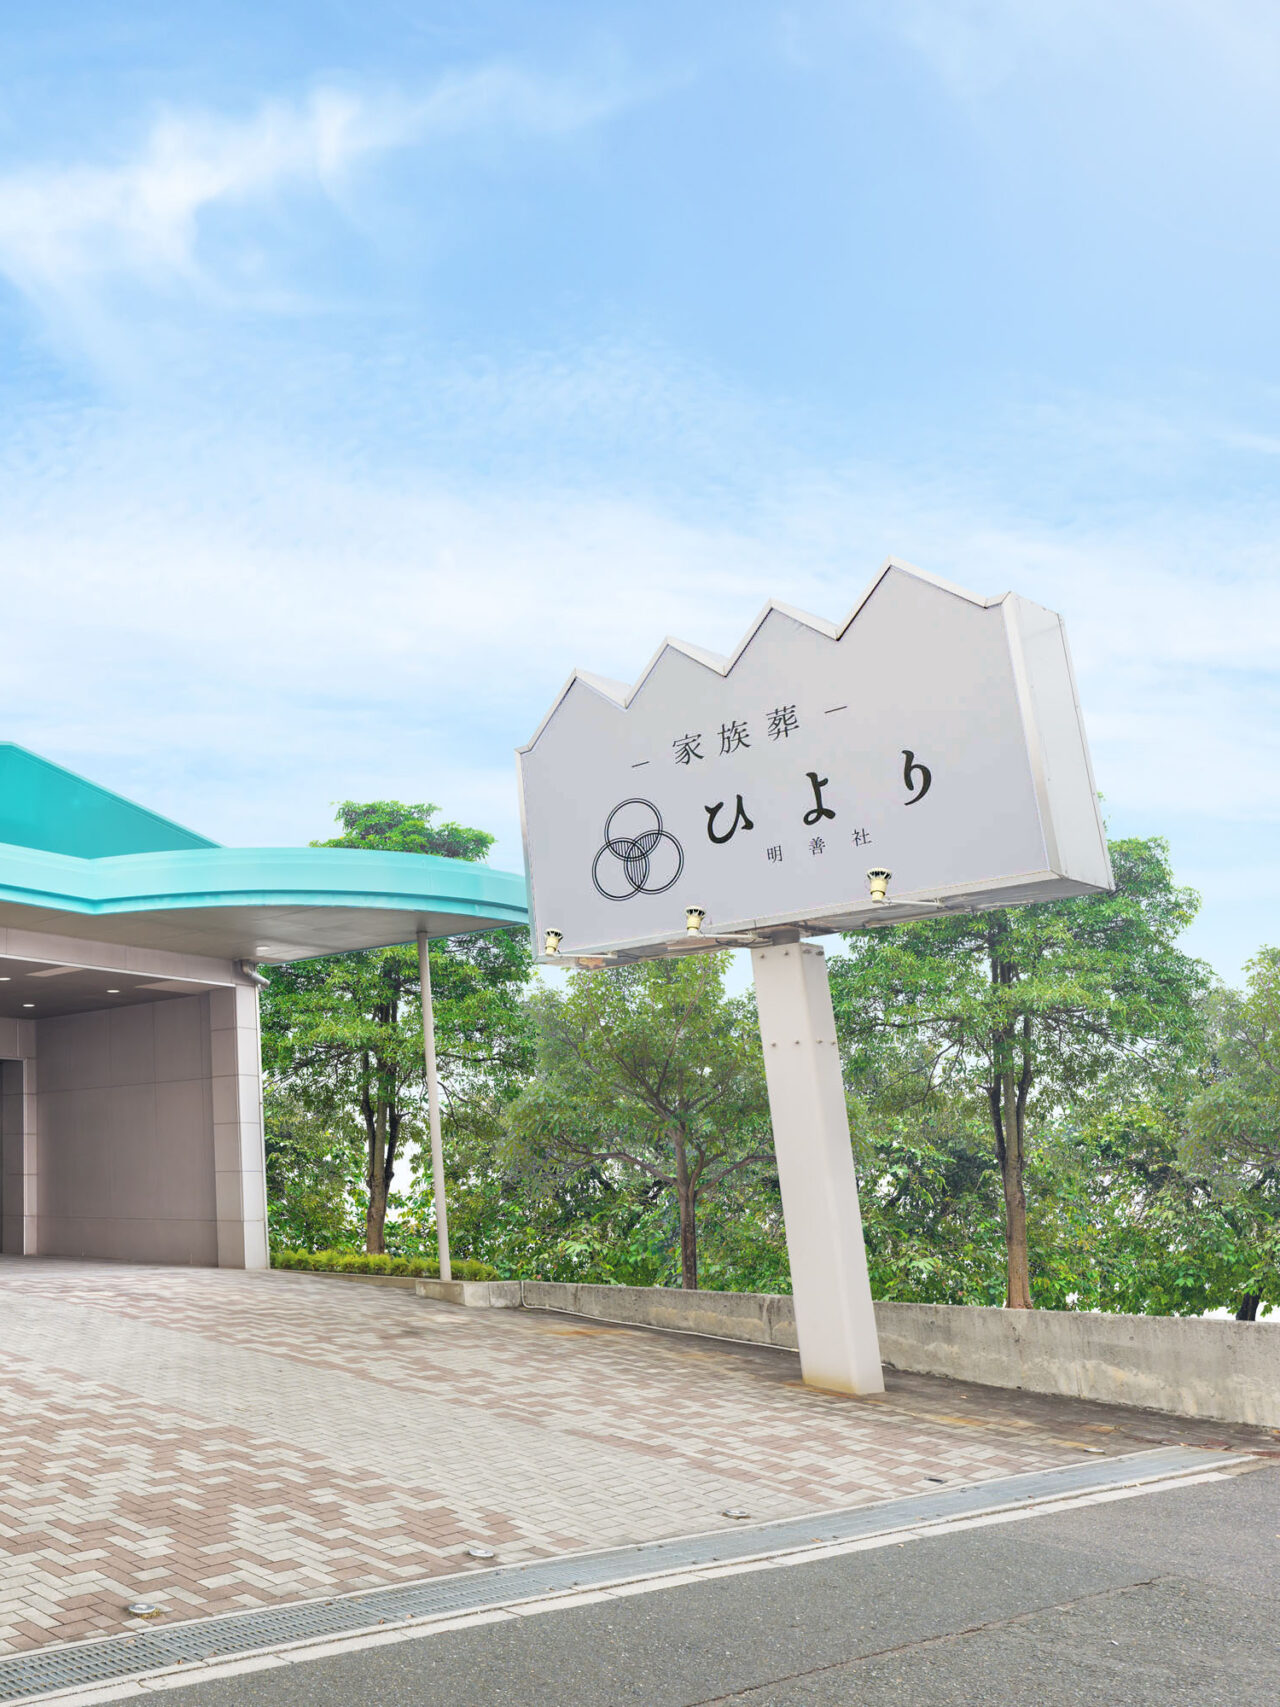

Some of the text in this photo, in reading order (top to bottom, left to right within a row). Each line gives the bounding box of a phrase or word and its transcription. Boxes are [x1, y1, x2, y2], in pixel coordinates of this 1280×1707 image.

[672, 704, 800, 766] 家族葬
[704, 749, 932, 844] ひより
[766, 827, 873, 864] 明善社
